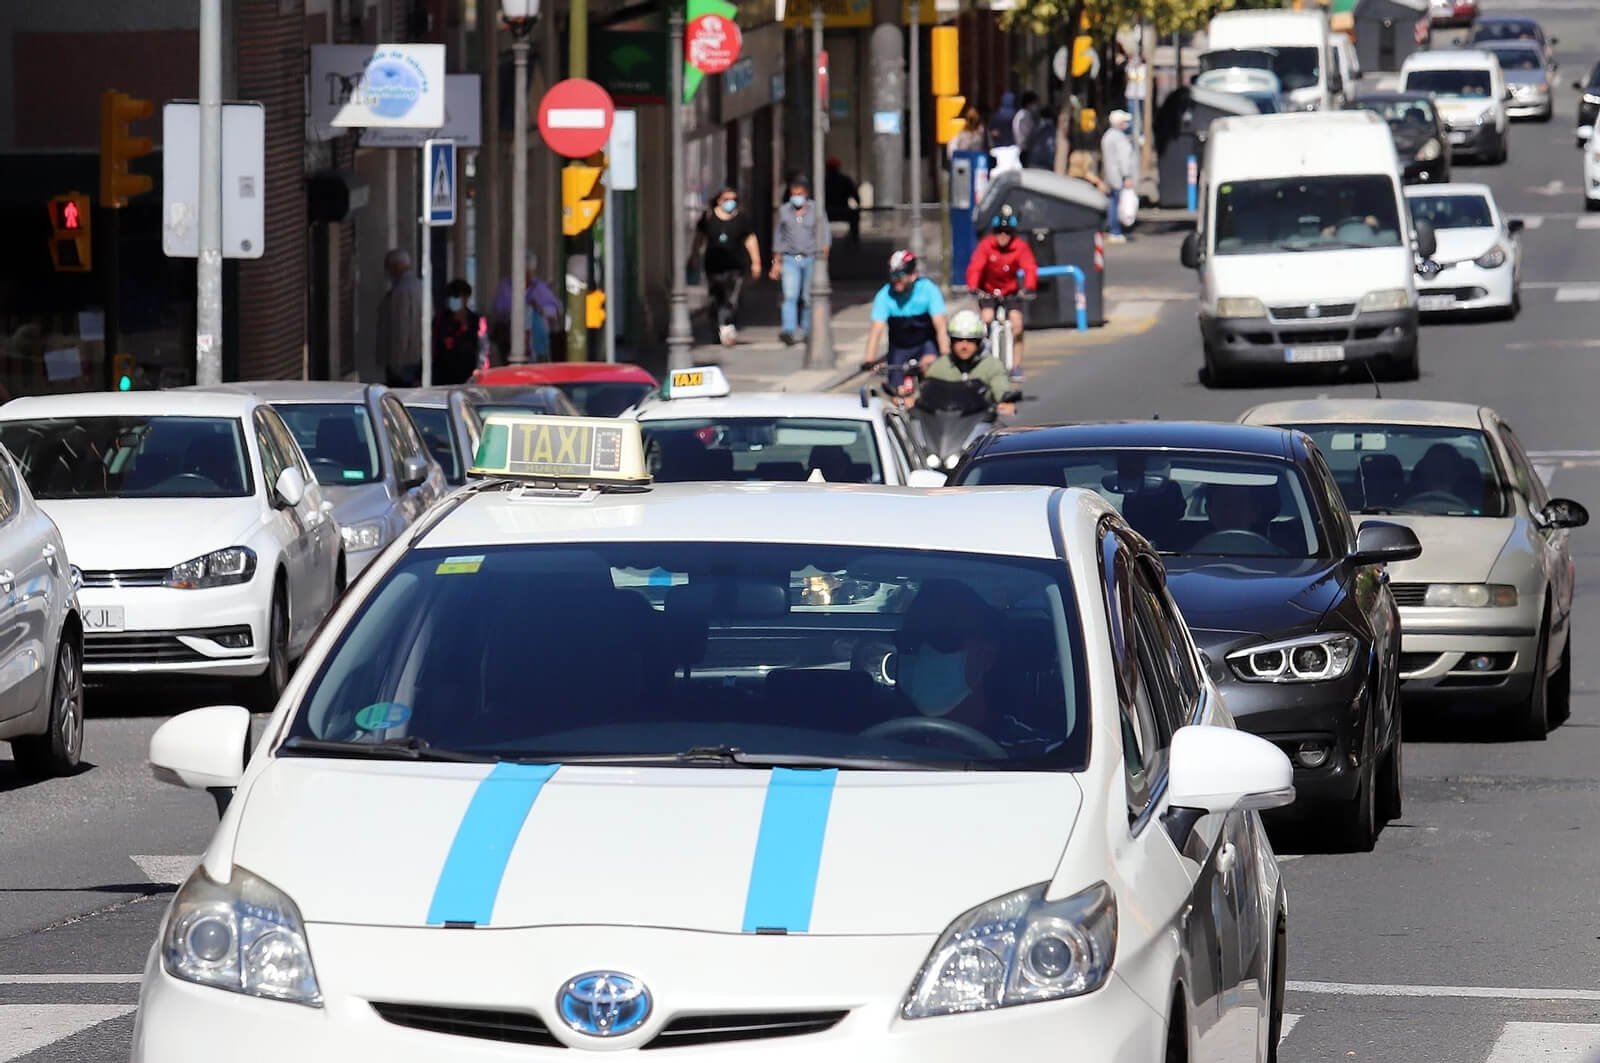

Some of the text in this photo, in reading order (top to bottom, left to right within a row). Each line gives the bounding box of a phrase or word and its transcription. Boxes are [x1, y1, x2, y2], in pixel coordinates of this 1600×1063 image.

[674, 372, 703, 386] TAXI
[519, 424, 590, 464] TAXI
[81, 609, 117, 628] KJL
